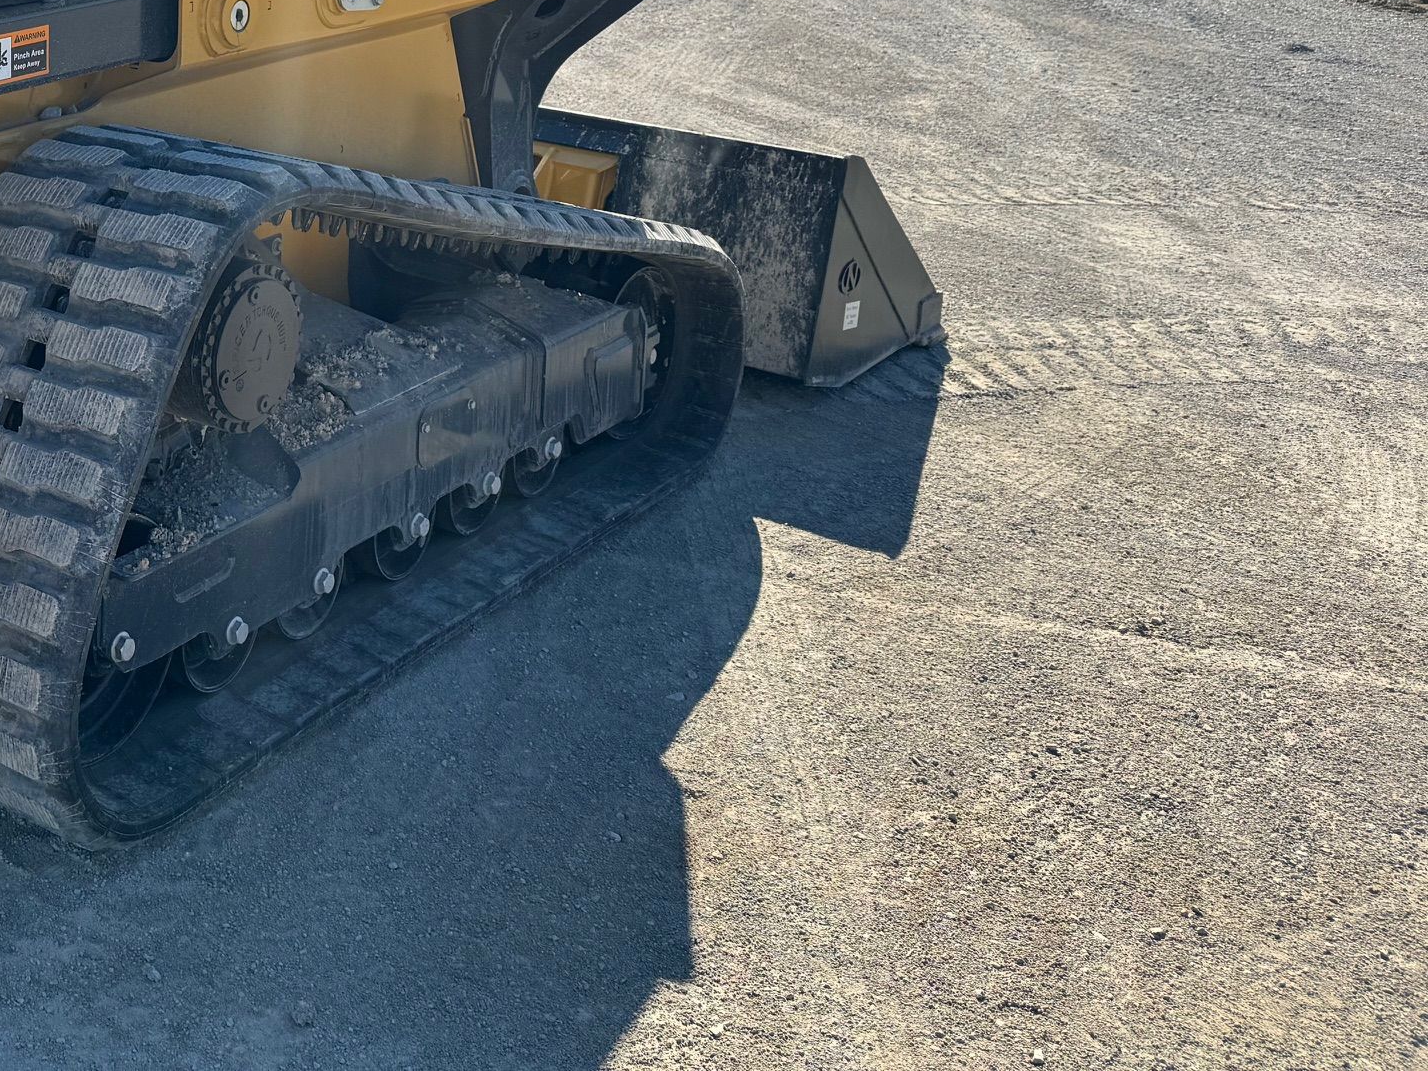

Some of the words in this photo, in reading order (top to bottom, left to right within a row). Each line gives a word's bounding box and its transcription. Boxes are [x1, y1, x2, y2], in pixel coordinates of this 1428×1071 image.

[19, 30, 46, 42] WARNING
[13, 51, 30, 61] Pinch
[30, 48, 45, 57] Area
[13, 62, 26, 71] Keep
[26, 59, 41, 68] Away
